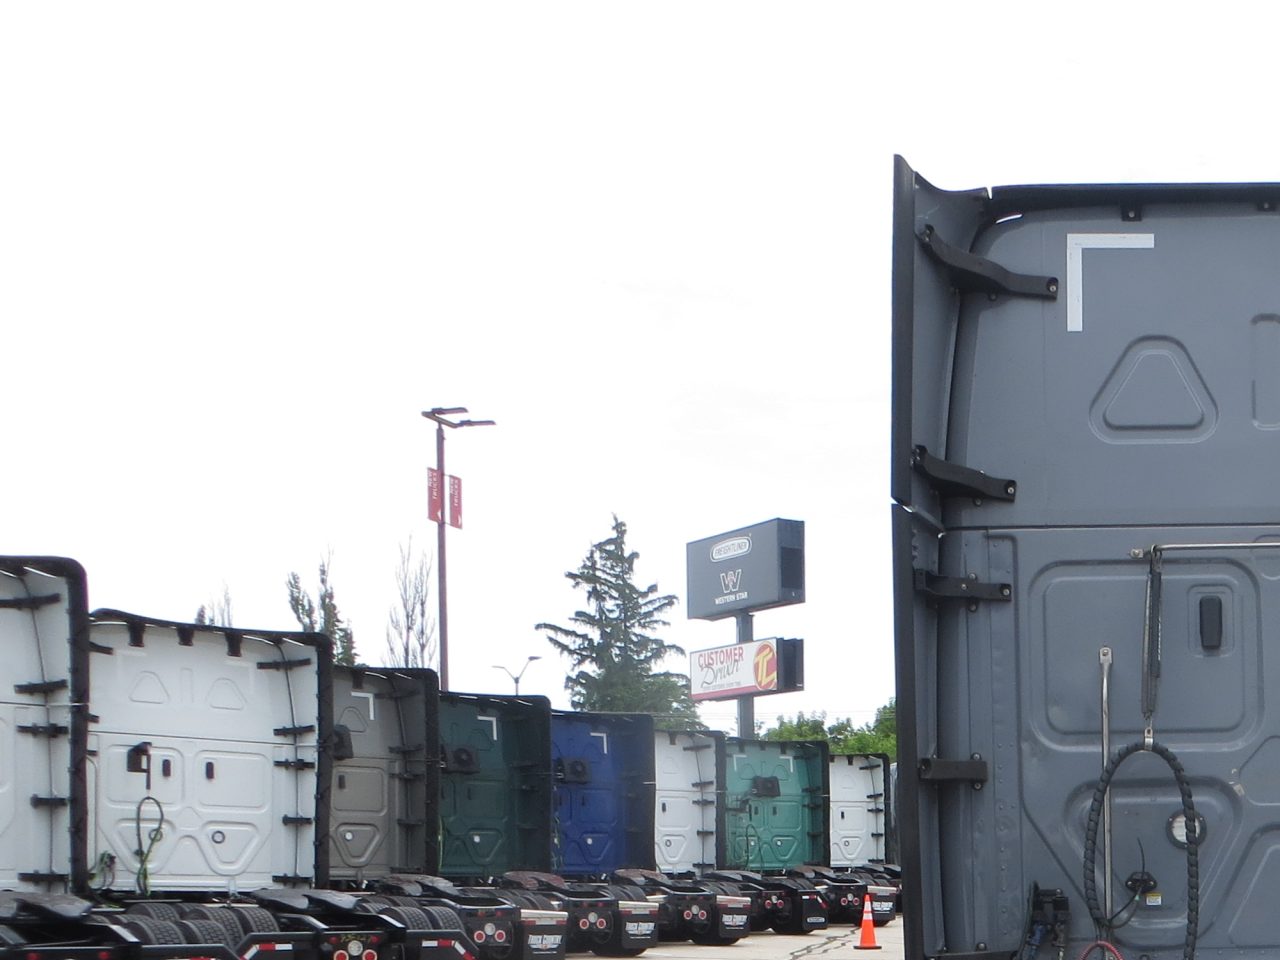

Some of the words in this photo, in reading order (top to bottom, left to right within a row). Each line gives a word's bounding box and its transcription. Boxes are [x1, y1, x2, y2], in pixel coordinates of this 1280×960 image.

[715, 541, 748, 557] FREIGHTLINER
[715, 594, 735, 605] WESTERN
[736, 591, 748, 601] STAR
[698, 646, 744, 670] CUSTOMER
